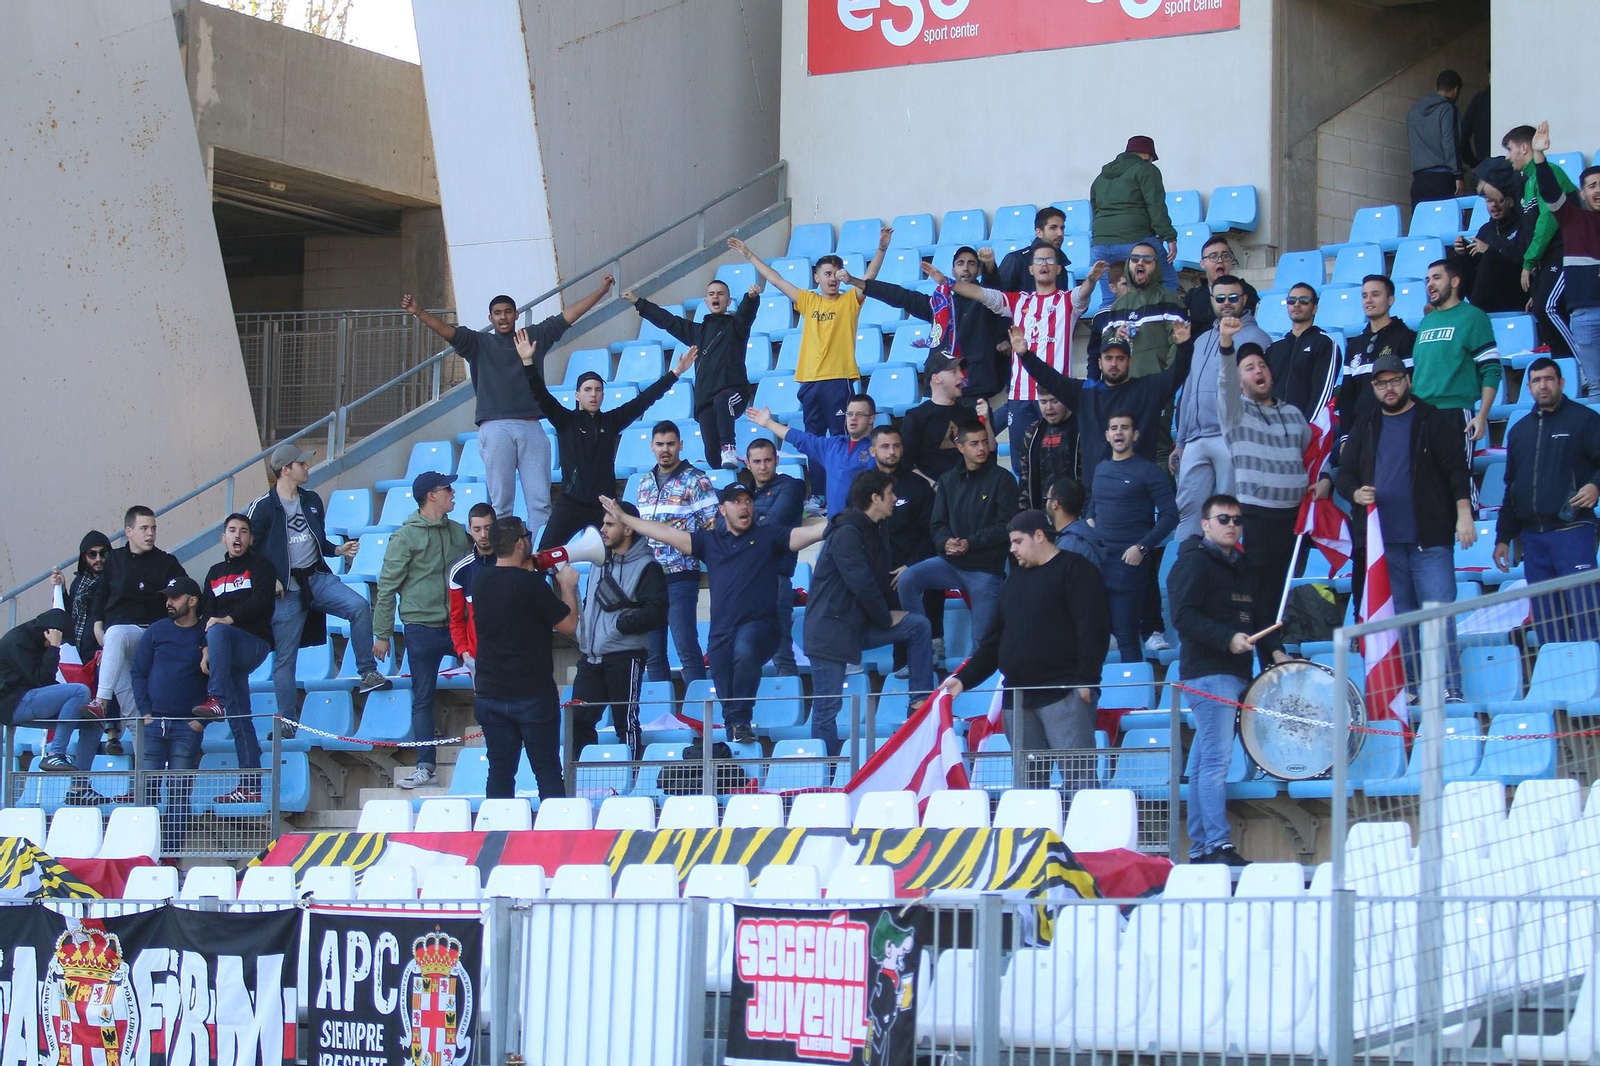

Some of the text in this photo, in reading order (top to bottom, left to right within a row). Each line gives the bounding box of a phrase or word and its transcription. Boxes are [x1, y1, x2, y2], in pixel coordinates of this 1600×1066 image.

[1164, 0, 1191, 17] sport
[923, 22, 980, 45] sport center
[316, 930, 400, 1015] APC
[44, 1006, 52, 1032] NOBLE
[123, 985, 135, 1056] POR LA LIBERTAD
[319, 1020, 385, 1052] SIEMPRE
